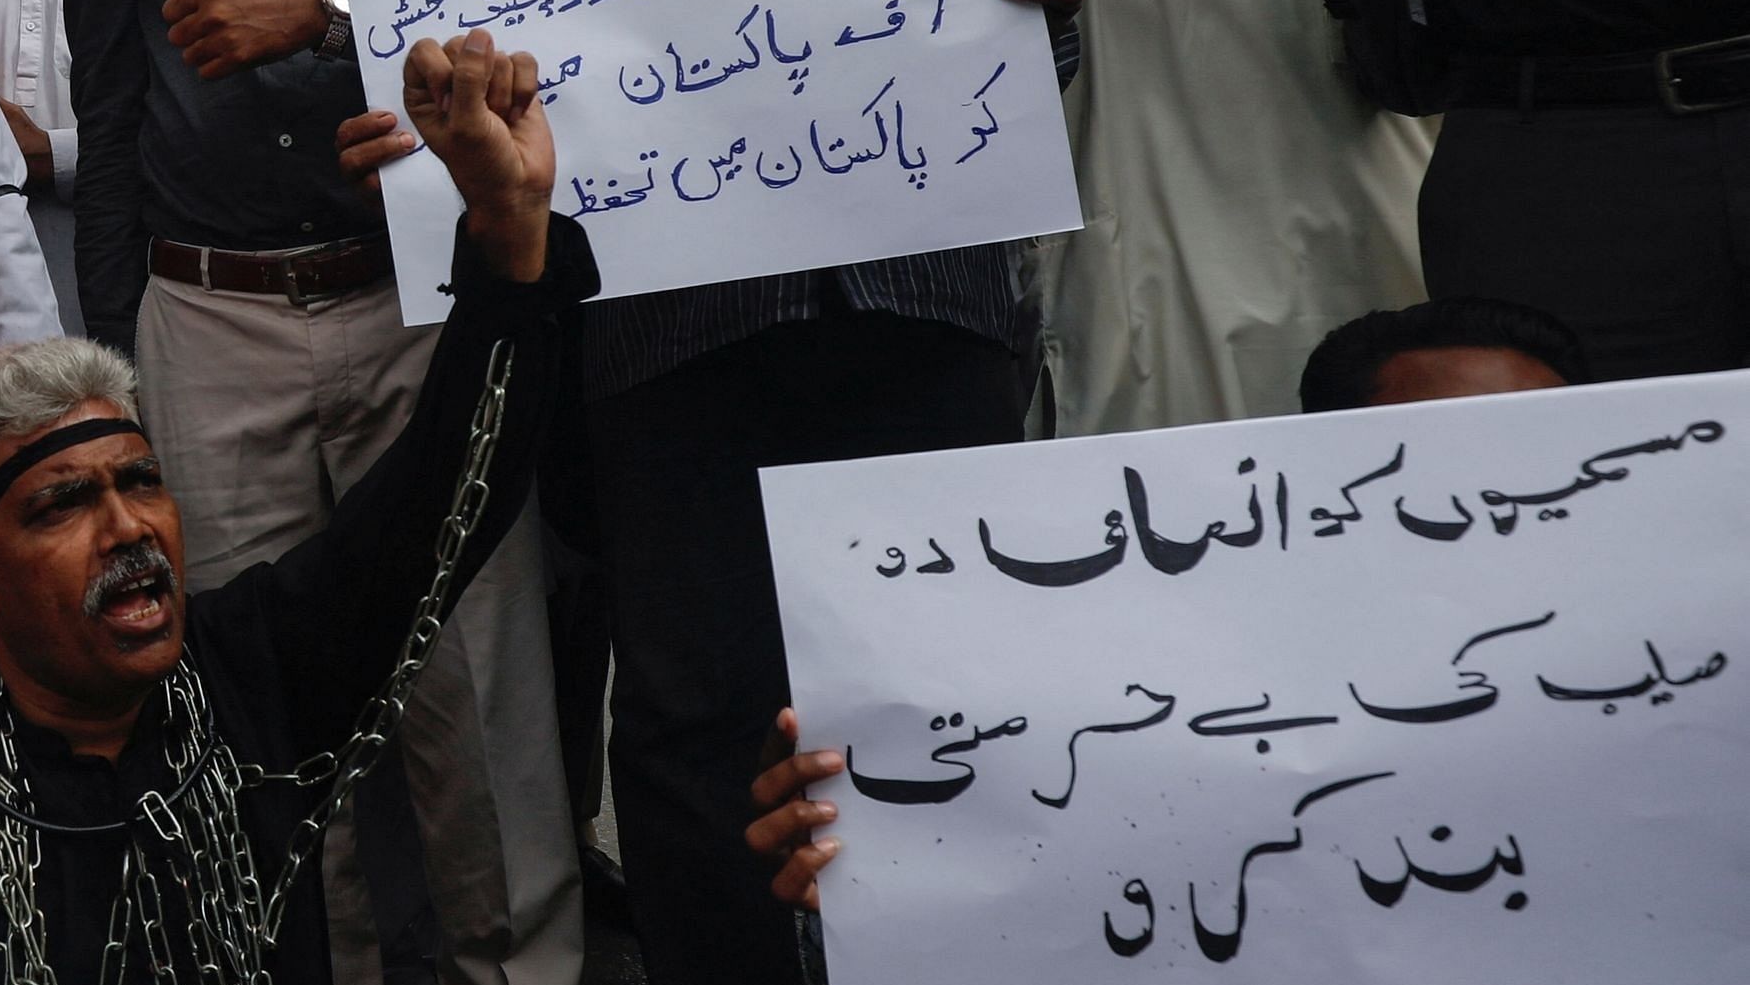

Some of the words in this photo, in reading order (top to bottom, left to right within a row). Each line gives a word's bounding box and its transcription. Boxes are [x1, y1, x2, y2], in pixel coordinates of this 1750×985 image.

[618, 4, 813, 105] پاکستان
[670, 136, 747, 202] میں
[754, 74, 930, 192] پاکستان
[1310, 442, 1408, 538] کو
[875, 537, 956, 579] دو
[1537, 640, 1728, 715] صلیب
[1187, 692, 1339, 755] بے
[1354, 825, 1529, 911] بند
